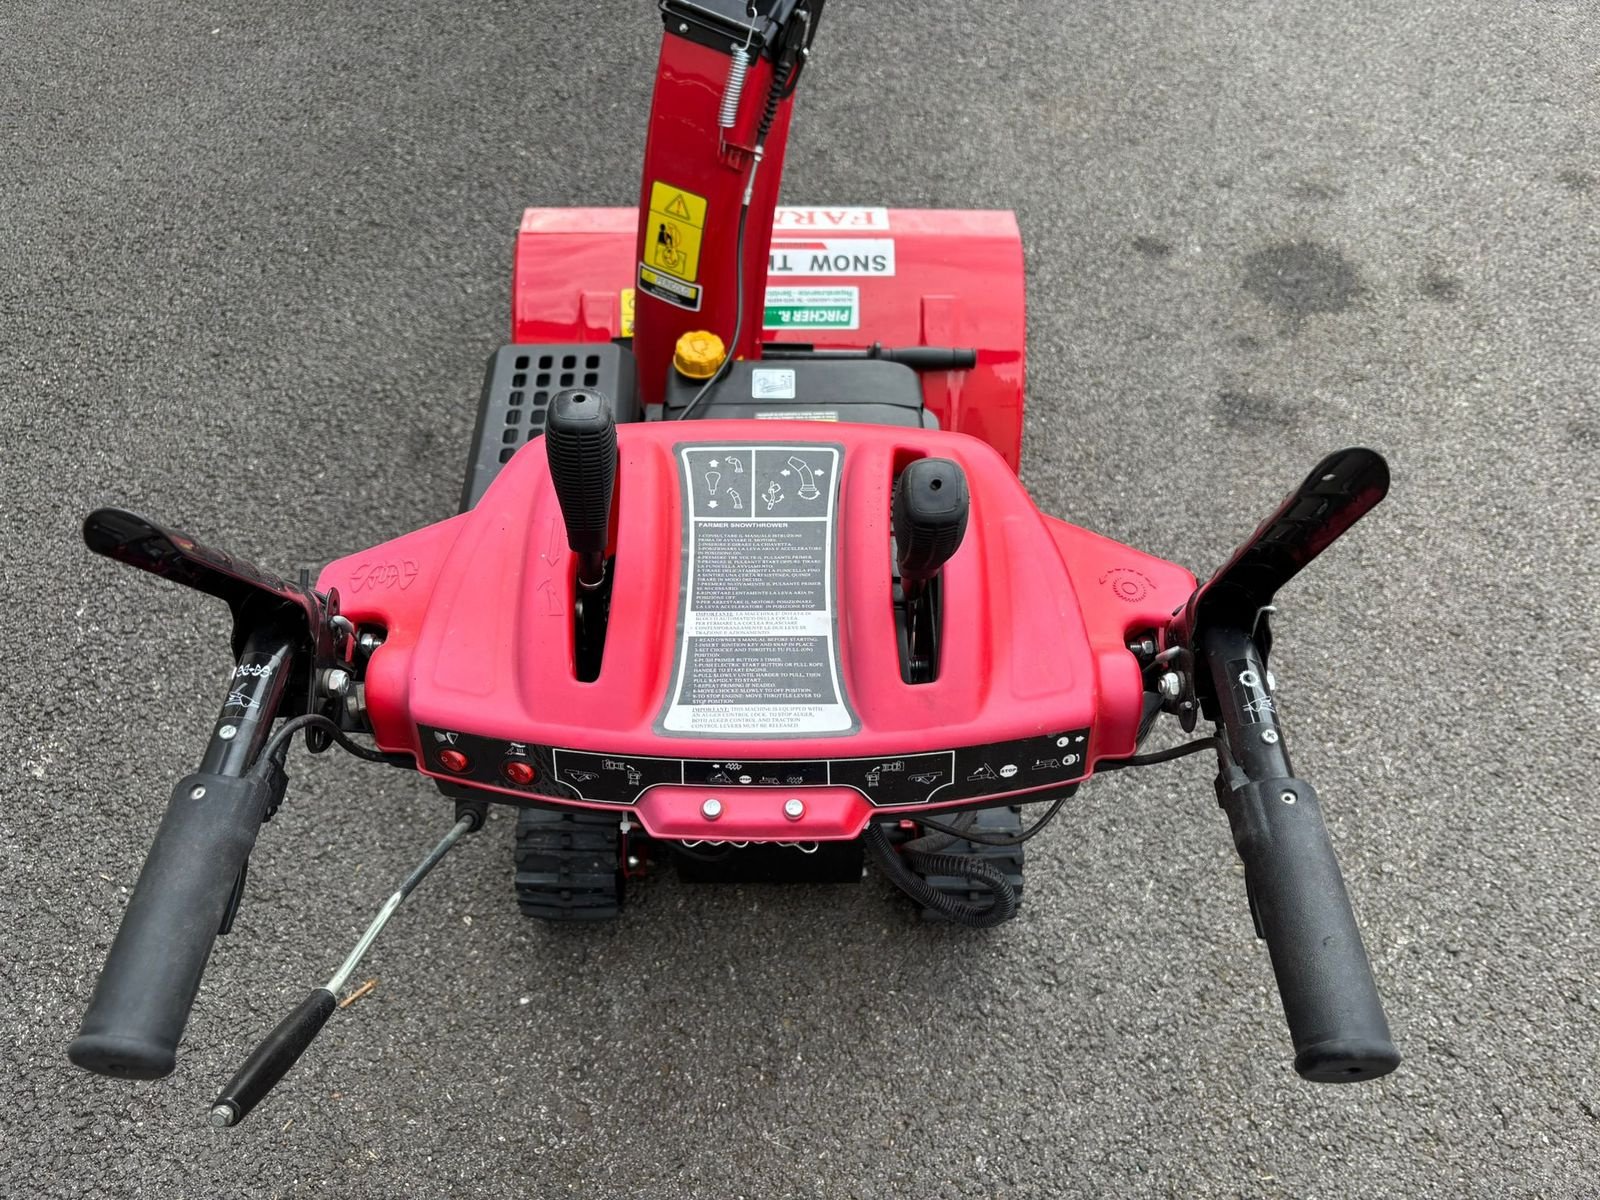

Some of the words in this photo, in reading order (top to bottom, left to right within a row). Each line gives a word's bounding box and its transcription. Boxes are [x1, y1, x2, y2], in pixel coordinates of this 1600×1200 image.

[809, 254, 887, 272] SNOW
[777, 310, 791, 323] R.
[792, 310, 850, 323] PIRCHER
